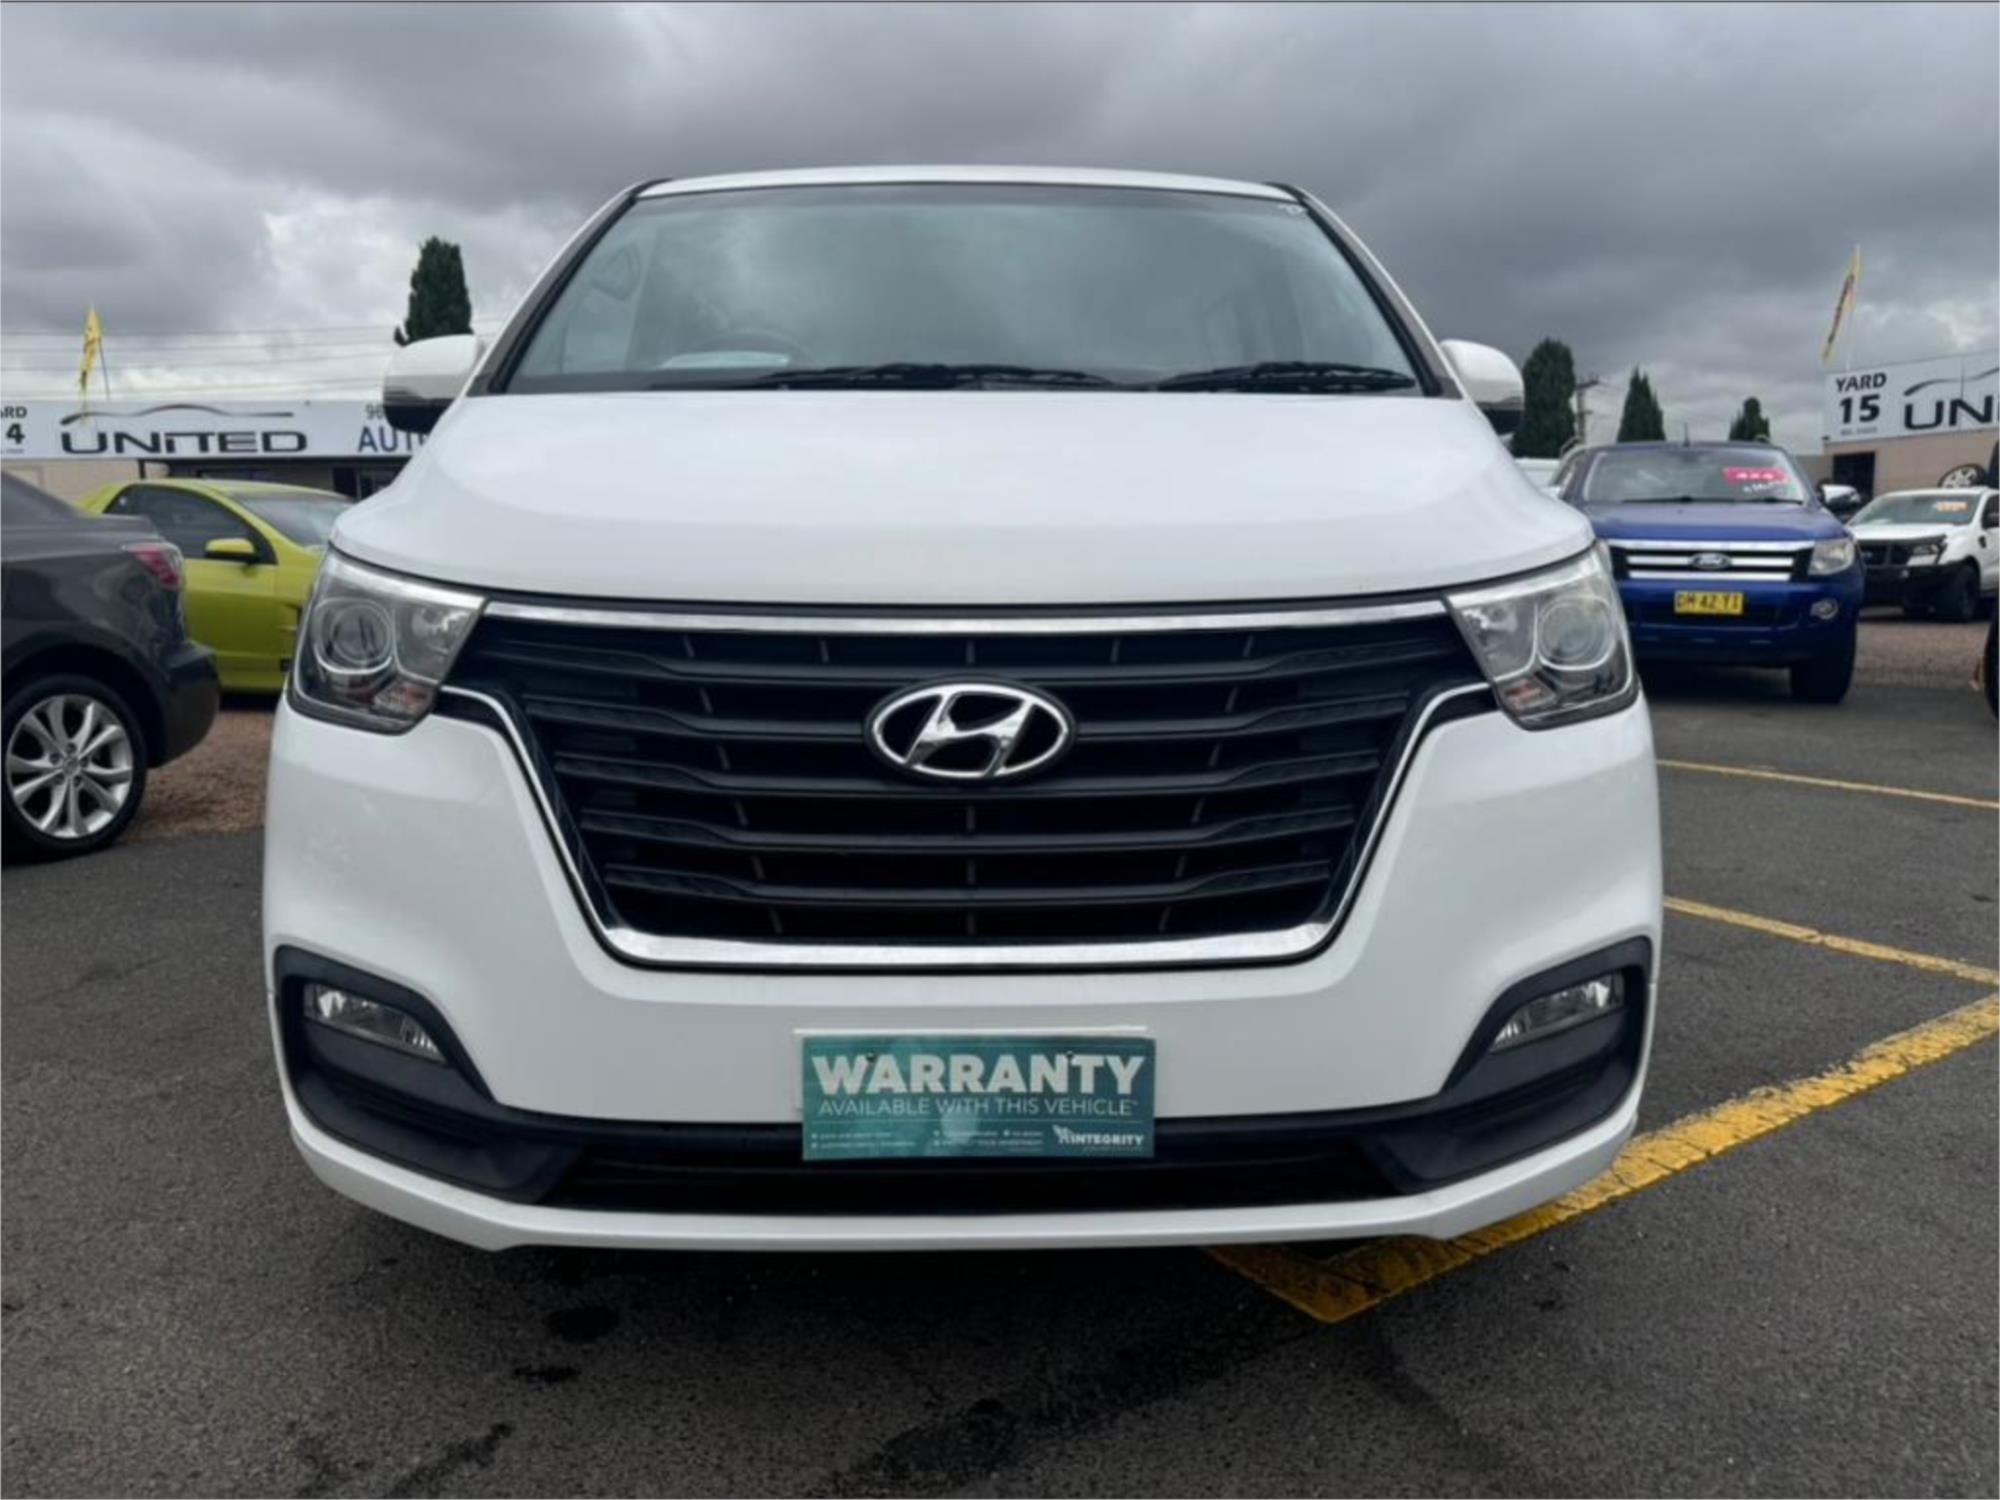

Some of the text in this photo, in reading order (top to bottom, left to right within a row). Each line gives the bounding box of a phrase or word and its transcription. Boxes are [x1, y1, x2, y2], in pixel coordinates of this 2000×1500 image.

[1835, 372, 1887, 392] YARD
[1840, 393, 1880, 424] 15
[61, 431, 307, 454] UNITED
[812, 1053, 1145, 1094] WARRANTY
[818, 1098, 1133, 1116] AVAILABLE WITH THIS VEHICLE
